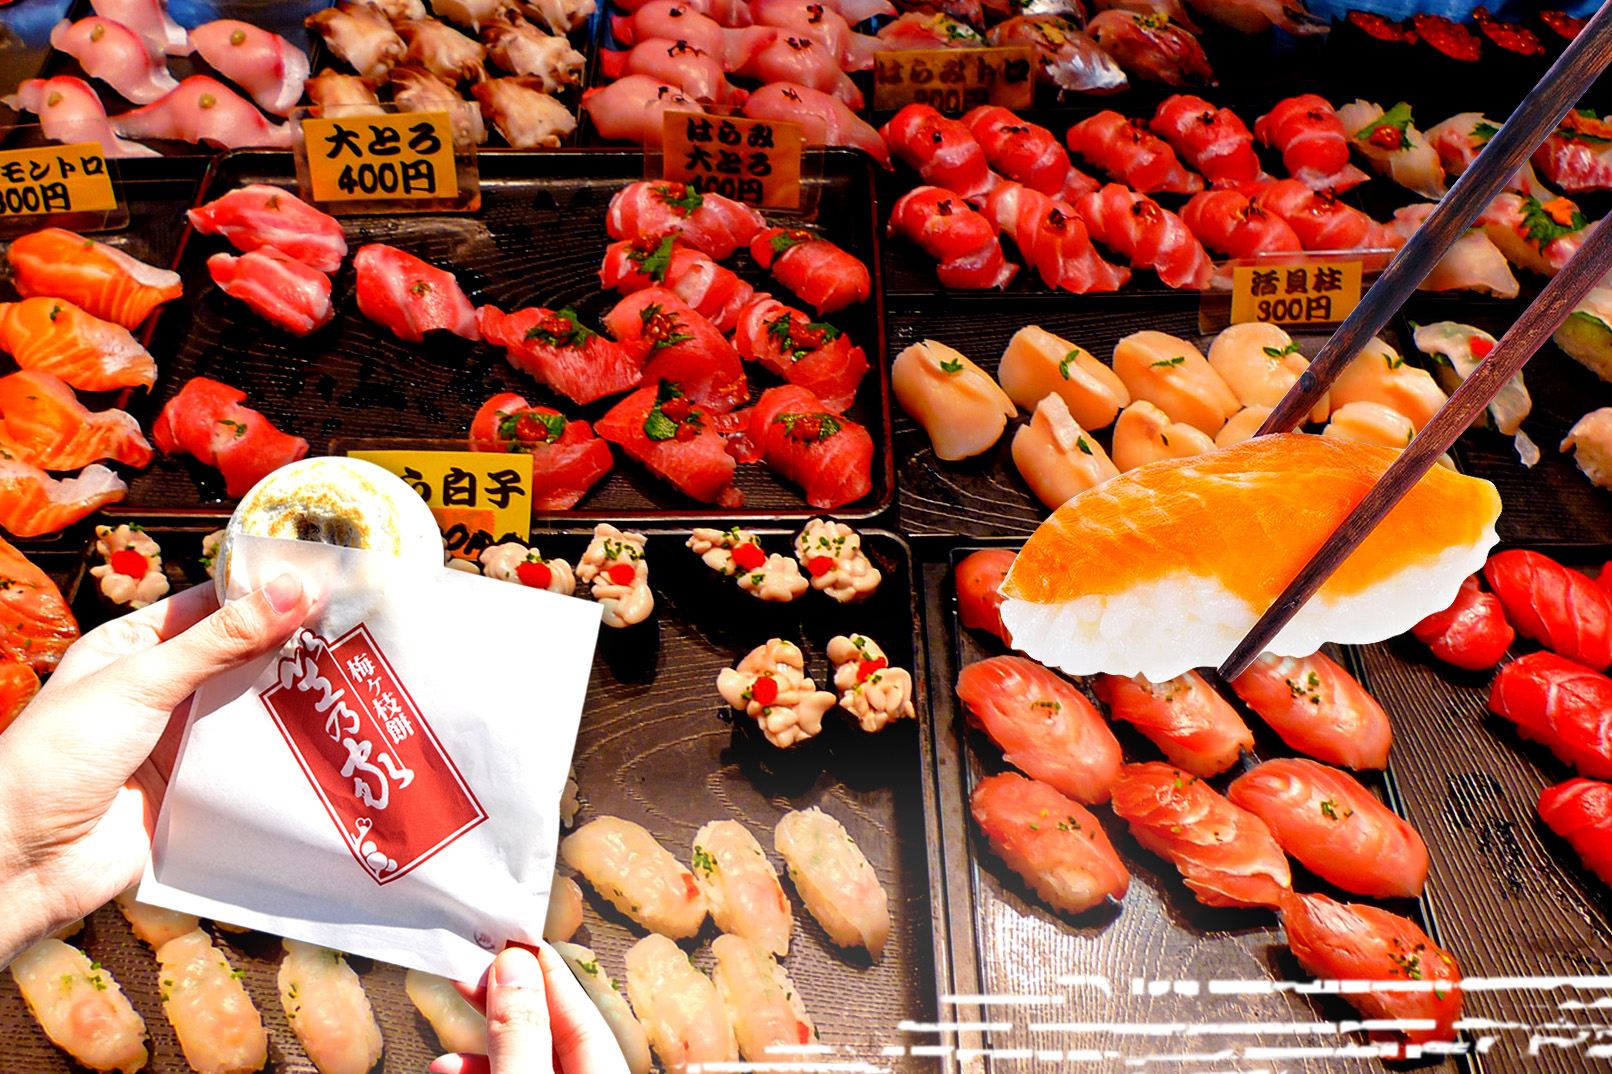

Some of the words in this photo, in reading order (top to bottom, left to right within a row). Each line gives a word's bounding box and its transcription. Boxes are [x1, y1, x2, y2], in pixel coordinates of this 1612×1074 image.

[324, 122, 442, 159] 大とろ
[686, 117, 775, 149] はらみ
[337, 159, 436, 195] 400円
[684, 145, 773, 177] 大とろ
[1250, 266, 1343, 297] 活貝柱
[1257, 295, 1333, 322] 300円
